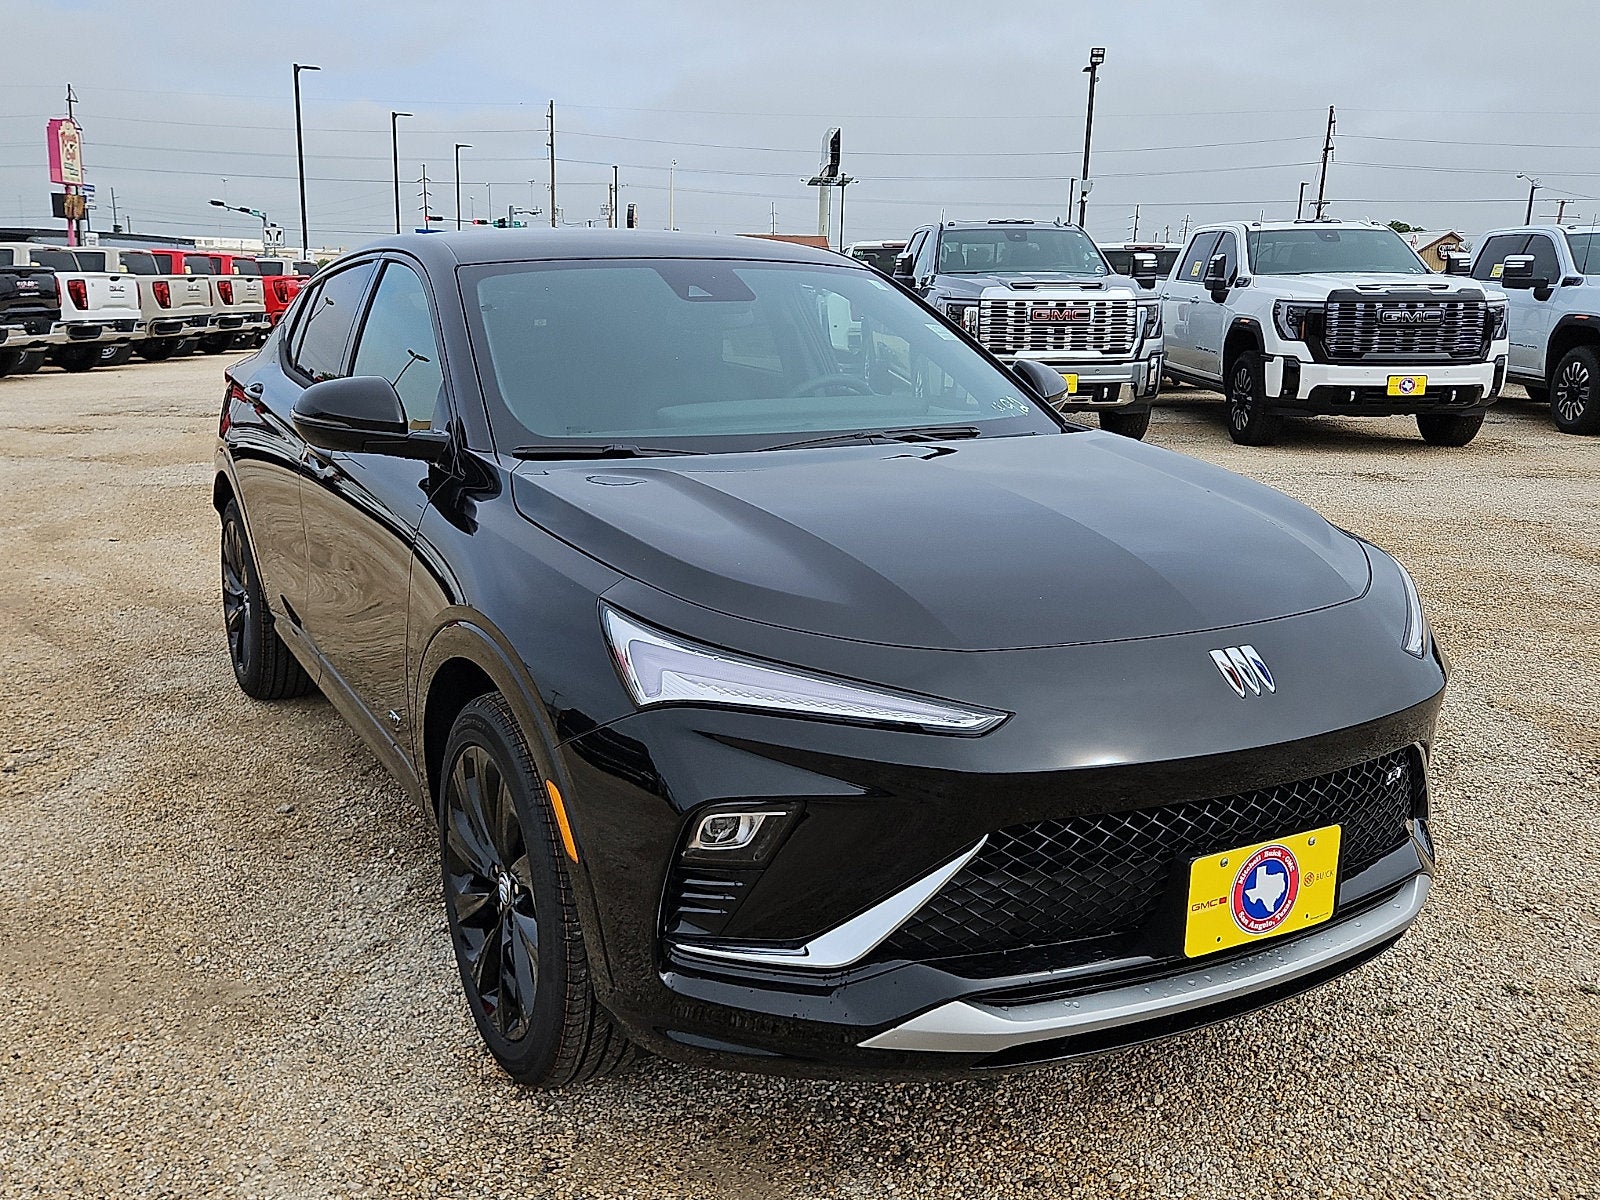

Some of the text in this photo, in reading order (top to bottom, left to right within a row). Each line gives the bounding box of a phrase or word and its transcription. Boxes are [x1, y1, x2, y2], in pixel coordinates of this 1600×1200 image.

[1032, 309, 1090, 321] GMC
[1382, 311, 1442, 323] GMC
[1238, 855, 1261, 885] Mitchell
[1264, 850, 1282, 858] Buick
[1284, 856, 1295, 872] GMC
[1191, 899, 1219, 912] GMC
[1238, 911, 1248, 926] San
[1248, 920, 1275, 930] Angelo,
